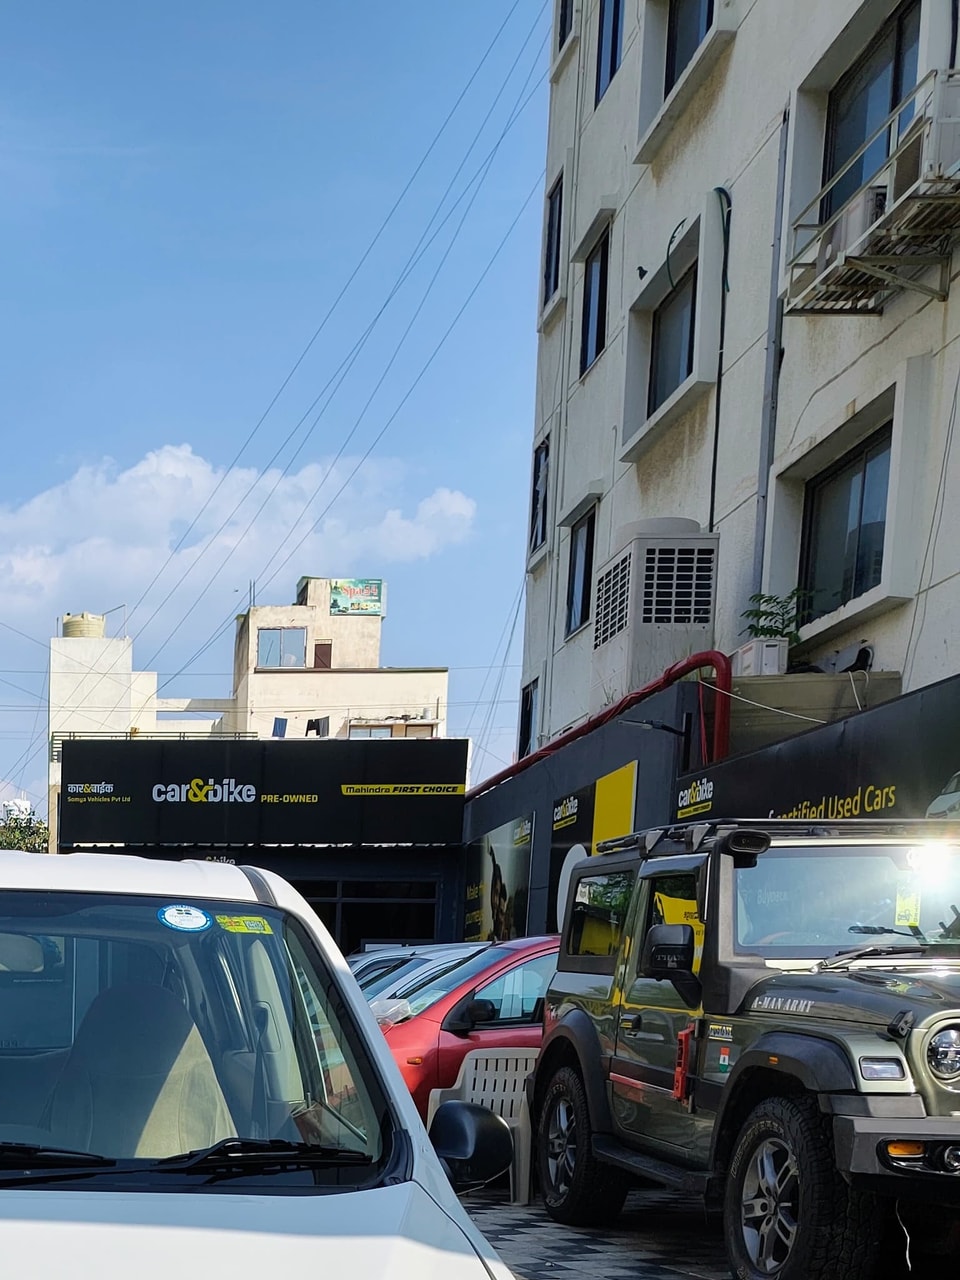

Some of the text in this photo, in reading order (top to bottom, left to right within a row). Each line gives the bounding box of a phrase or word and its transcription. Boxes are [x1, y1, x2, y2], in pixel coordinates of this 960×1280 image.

[152, 778, 318, 803] car&bike PRE-OWNED
[678, 778, 713, 807] car&bike
[828, 787, 861, 819] Used
[864, 785, 895, 812] Cars
[783, 999, 815, 1012] ARMY
